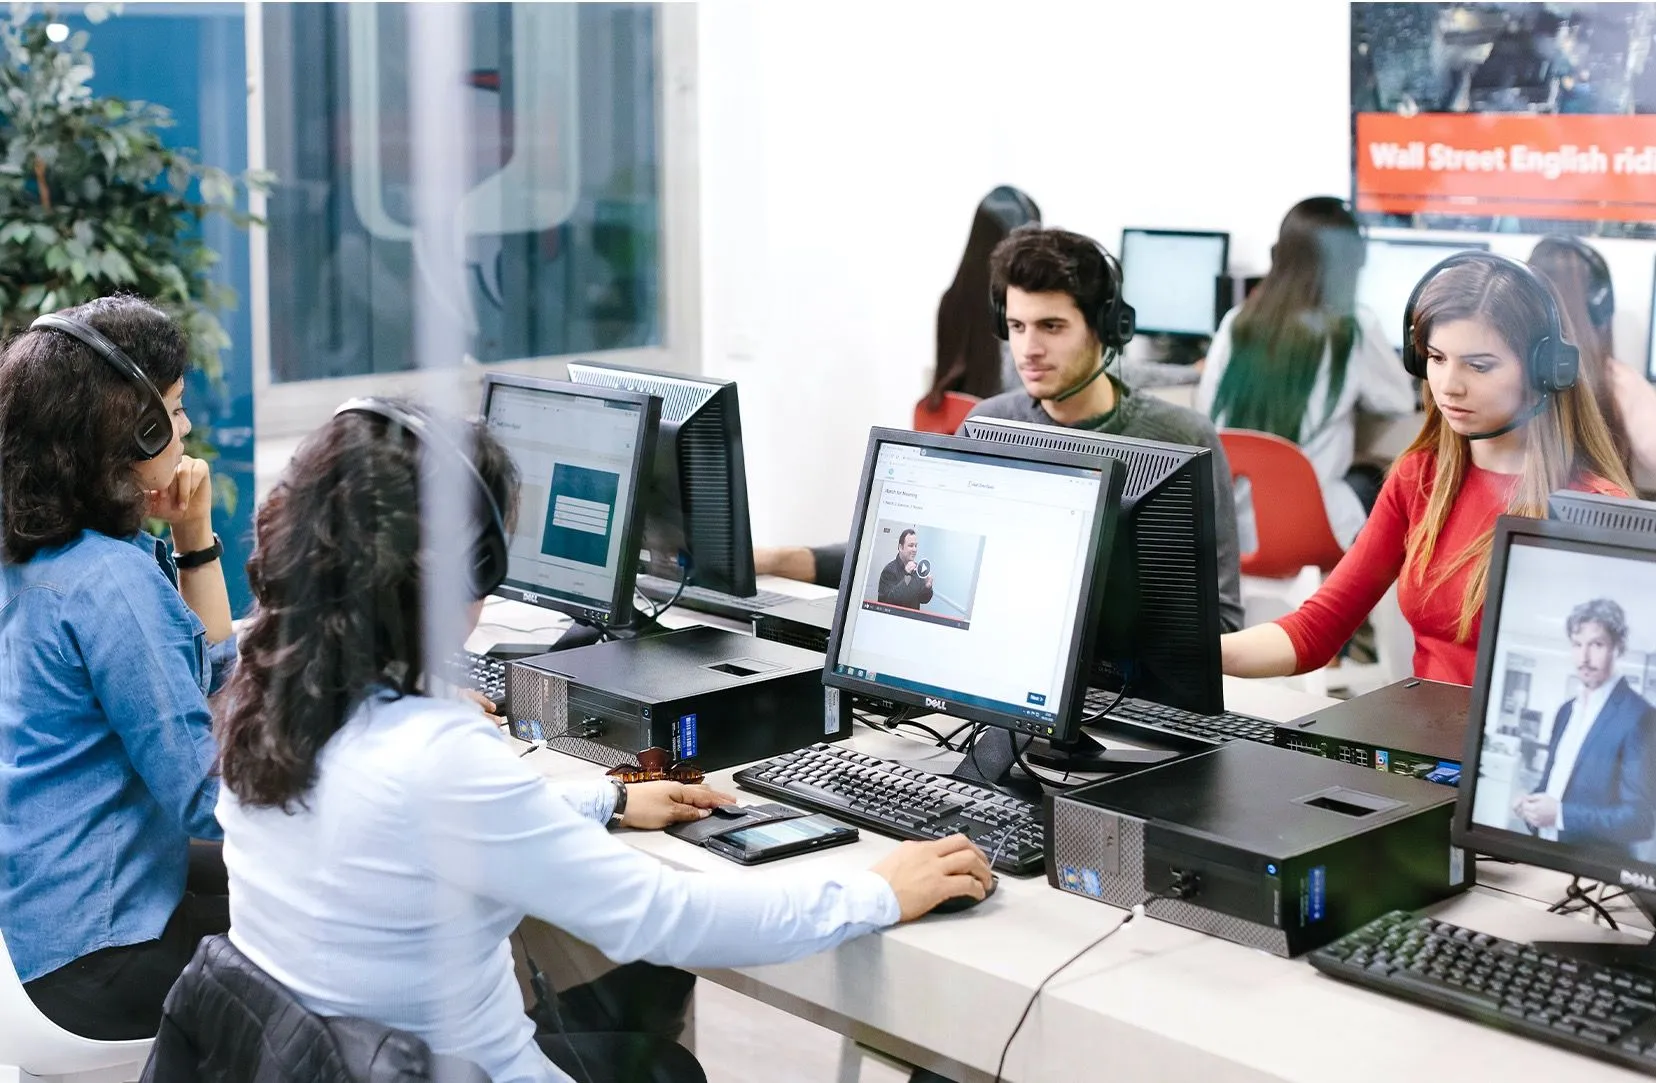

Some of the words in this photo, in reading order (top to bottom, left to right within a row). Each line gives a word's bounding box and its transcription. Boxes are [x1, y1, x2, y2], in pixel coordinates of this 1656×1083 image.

[1370, 142, 1425, 170] Wall
[1428, 143, 1506, 171] Street
[1511, 145, 1608, 179] English
[925, 697, 947, 711] DELL
